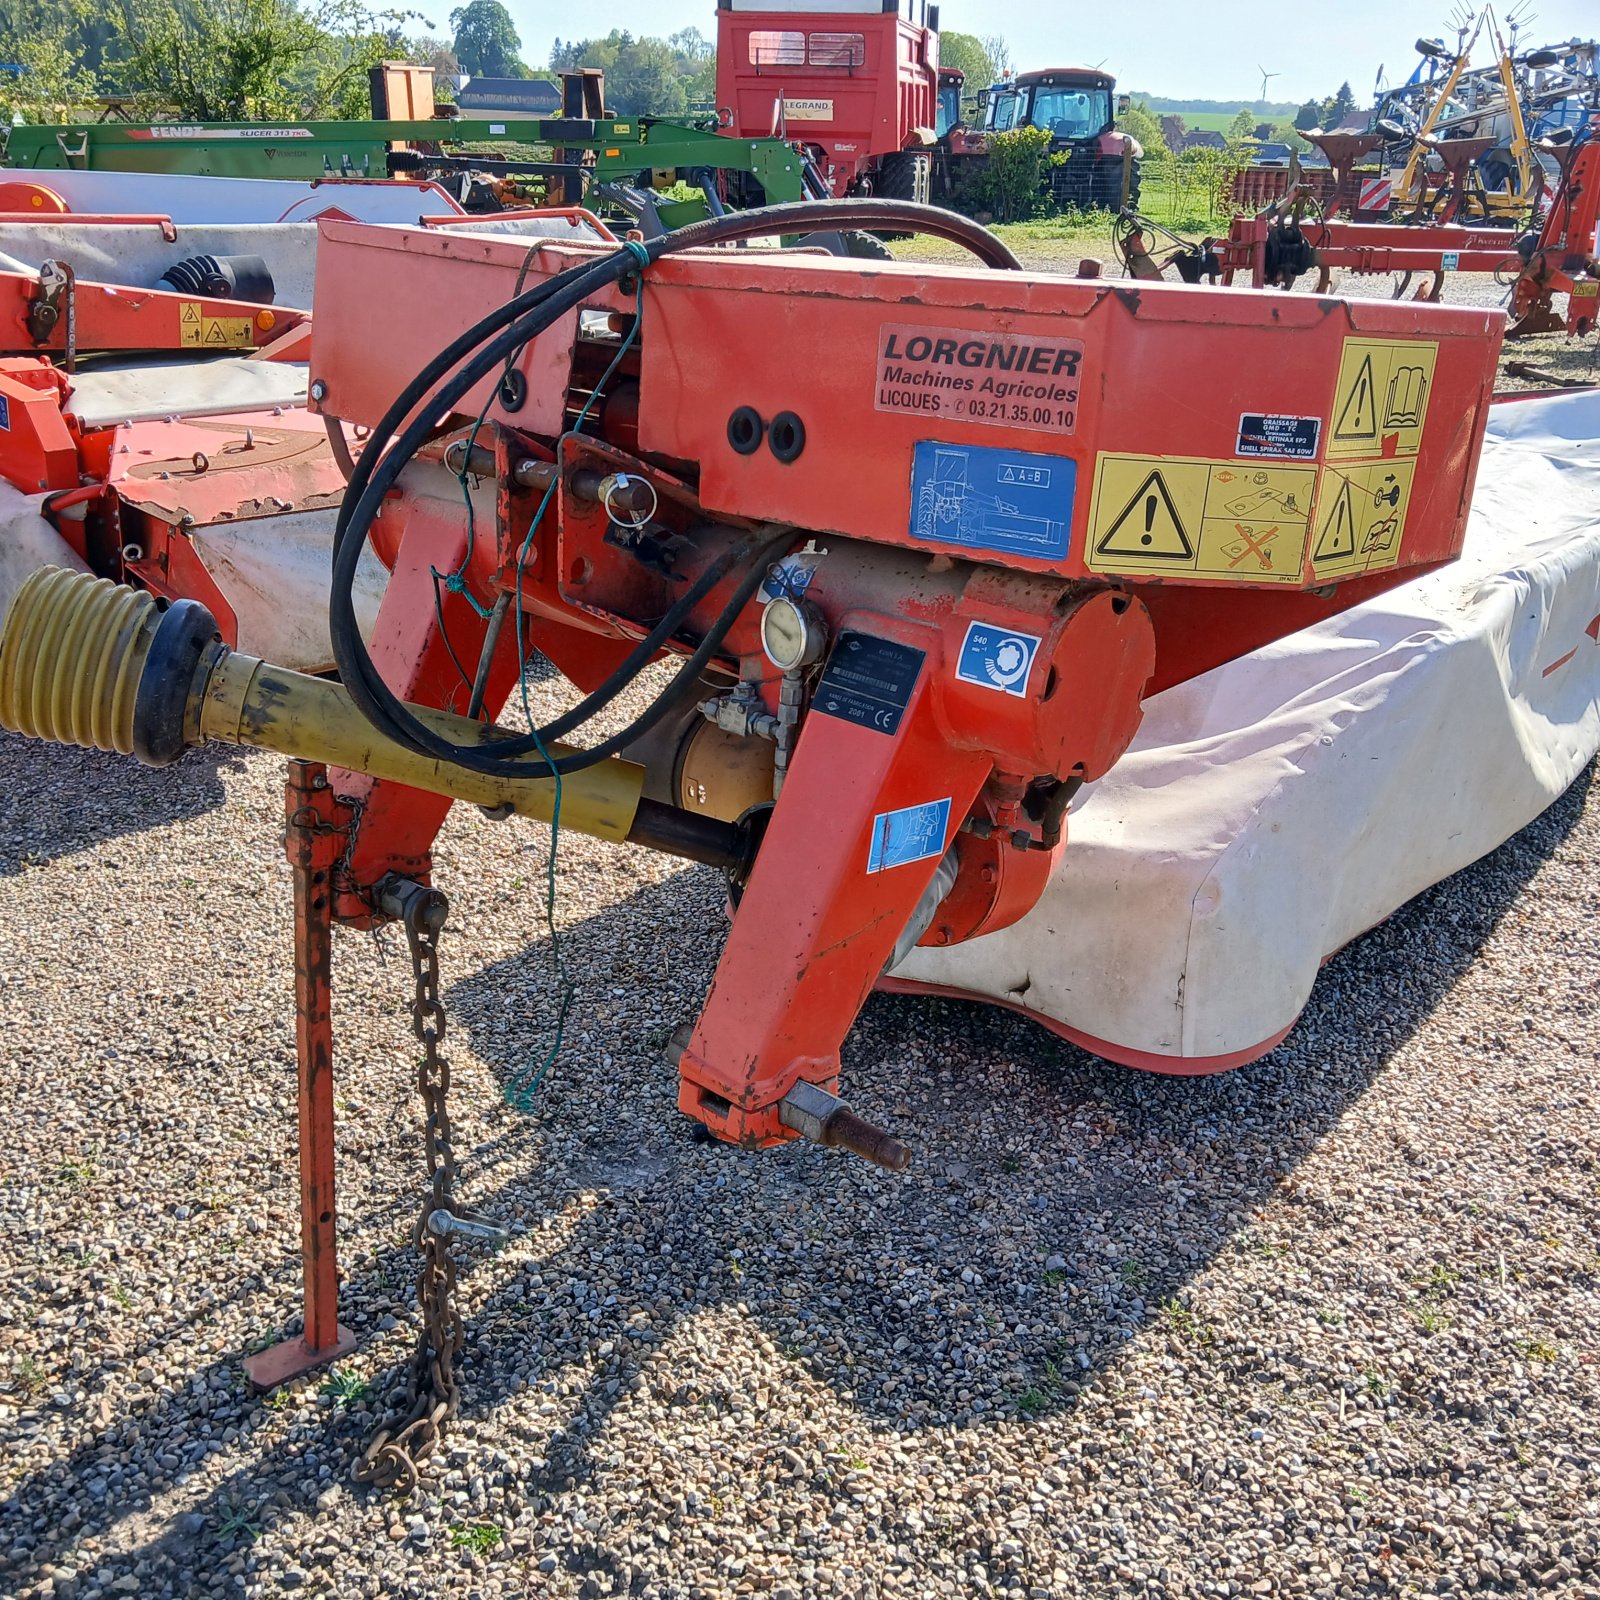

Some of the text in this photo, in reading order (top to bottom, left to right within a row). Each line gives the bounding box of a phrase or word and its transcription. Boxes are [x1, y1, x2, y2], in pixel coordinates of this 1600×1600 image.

[785, 102, 828, 110] LEGRAND
[150, 126, 204, 138] FENDT
[884, 334, 1082, 377] LORGNIER
[883, 366, 1078, 403] Machines Agricoles
[880, 389, 941, 411] LICQUES
[969, 400, 1074, 427] 03.21.35.00.10
[1263, 419, 1298, 427] GRAISSAGE
[973, 635, 988, 645] 540
[848, 707, 865, 718] 2001
